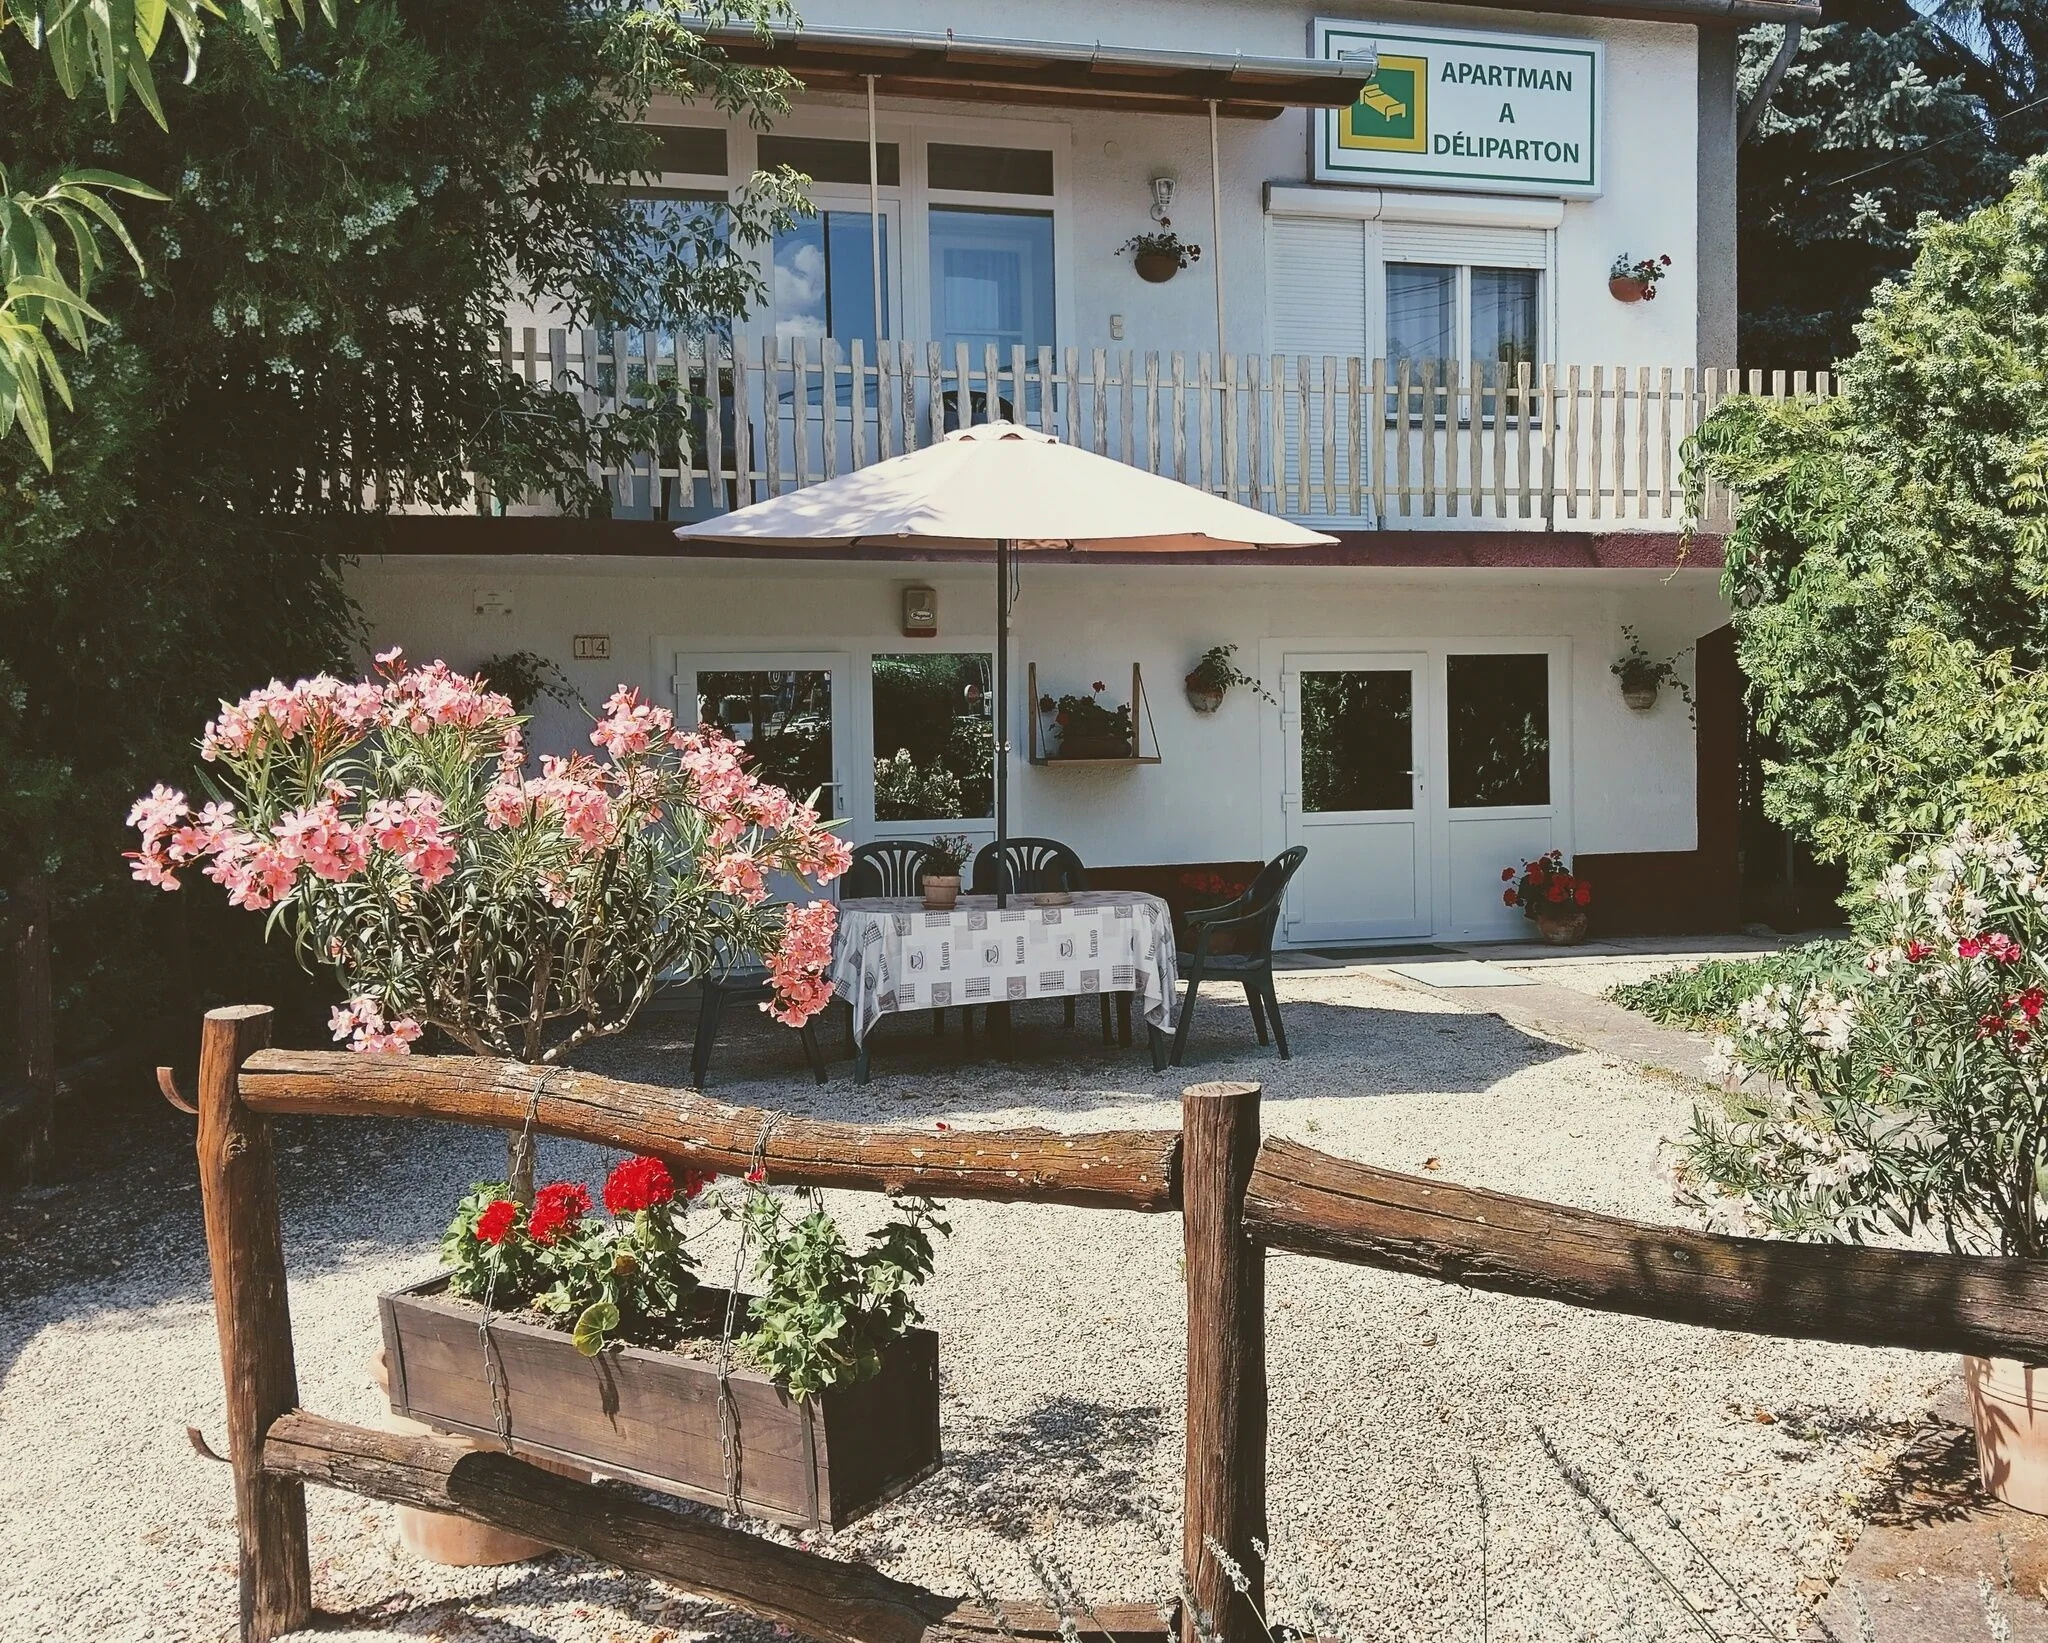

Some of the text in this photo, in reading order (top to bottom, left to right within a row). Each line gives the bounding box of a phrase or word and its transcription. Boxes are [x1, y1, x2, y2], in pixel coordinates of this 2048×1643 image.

[1441, 62, 1572, 91] APARTMAN
[1499, 102, 1515, 123] A
[1434, 131, 1579, 163] DÉLIPARTON
[581, 640, 607, 655] 14
